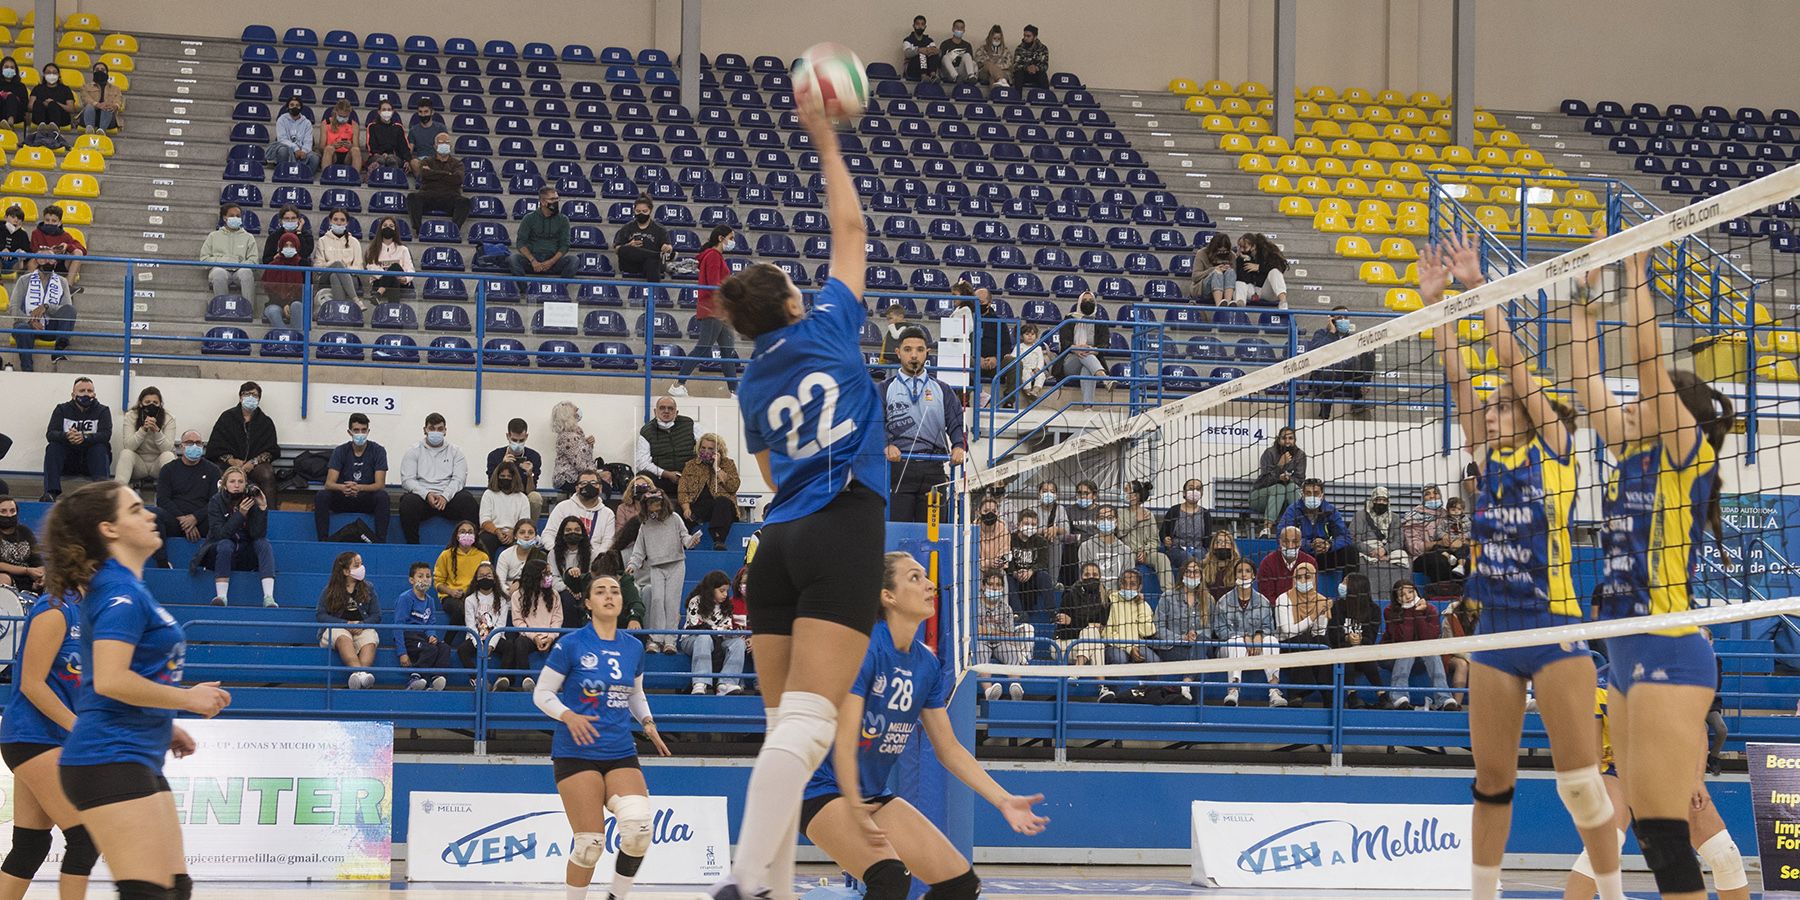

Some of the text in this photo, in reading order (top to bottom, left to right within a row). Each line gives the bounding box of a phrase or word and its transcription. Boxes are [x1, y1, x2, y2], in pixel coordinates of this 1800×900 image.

[1668, 202, 1720, 232] rfevb.com
[332, 394, 395, 411] SECTOR 3
[767, 371, 858, 461] 22
[1207, 426, 1263, 440] SECTOR 4
[607, 658, 623, 680] 3
[887, 677, 913, 712] 28
[237, 742, 269, 750] LONAS
[280, 742, 315, 750] MUCHO
[883, 732, 909, 744] SPORT
[164, 776, 386, 825] ENTER
[437, 804, 472, 813] MELILLA
[1223, 815, 1255, 823] MELILLA
[449, 833, 536, 868] VEN
[546, 842, 562, 857] A
[1240, 817, 1461, 875] VEN A Melilla
[1780, 865, 1800, 880] Se
